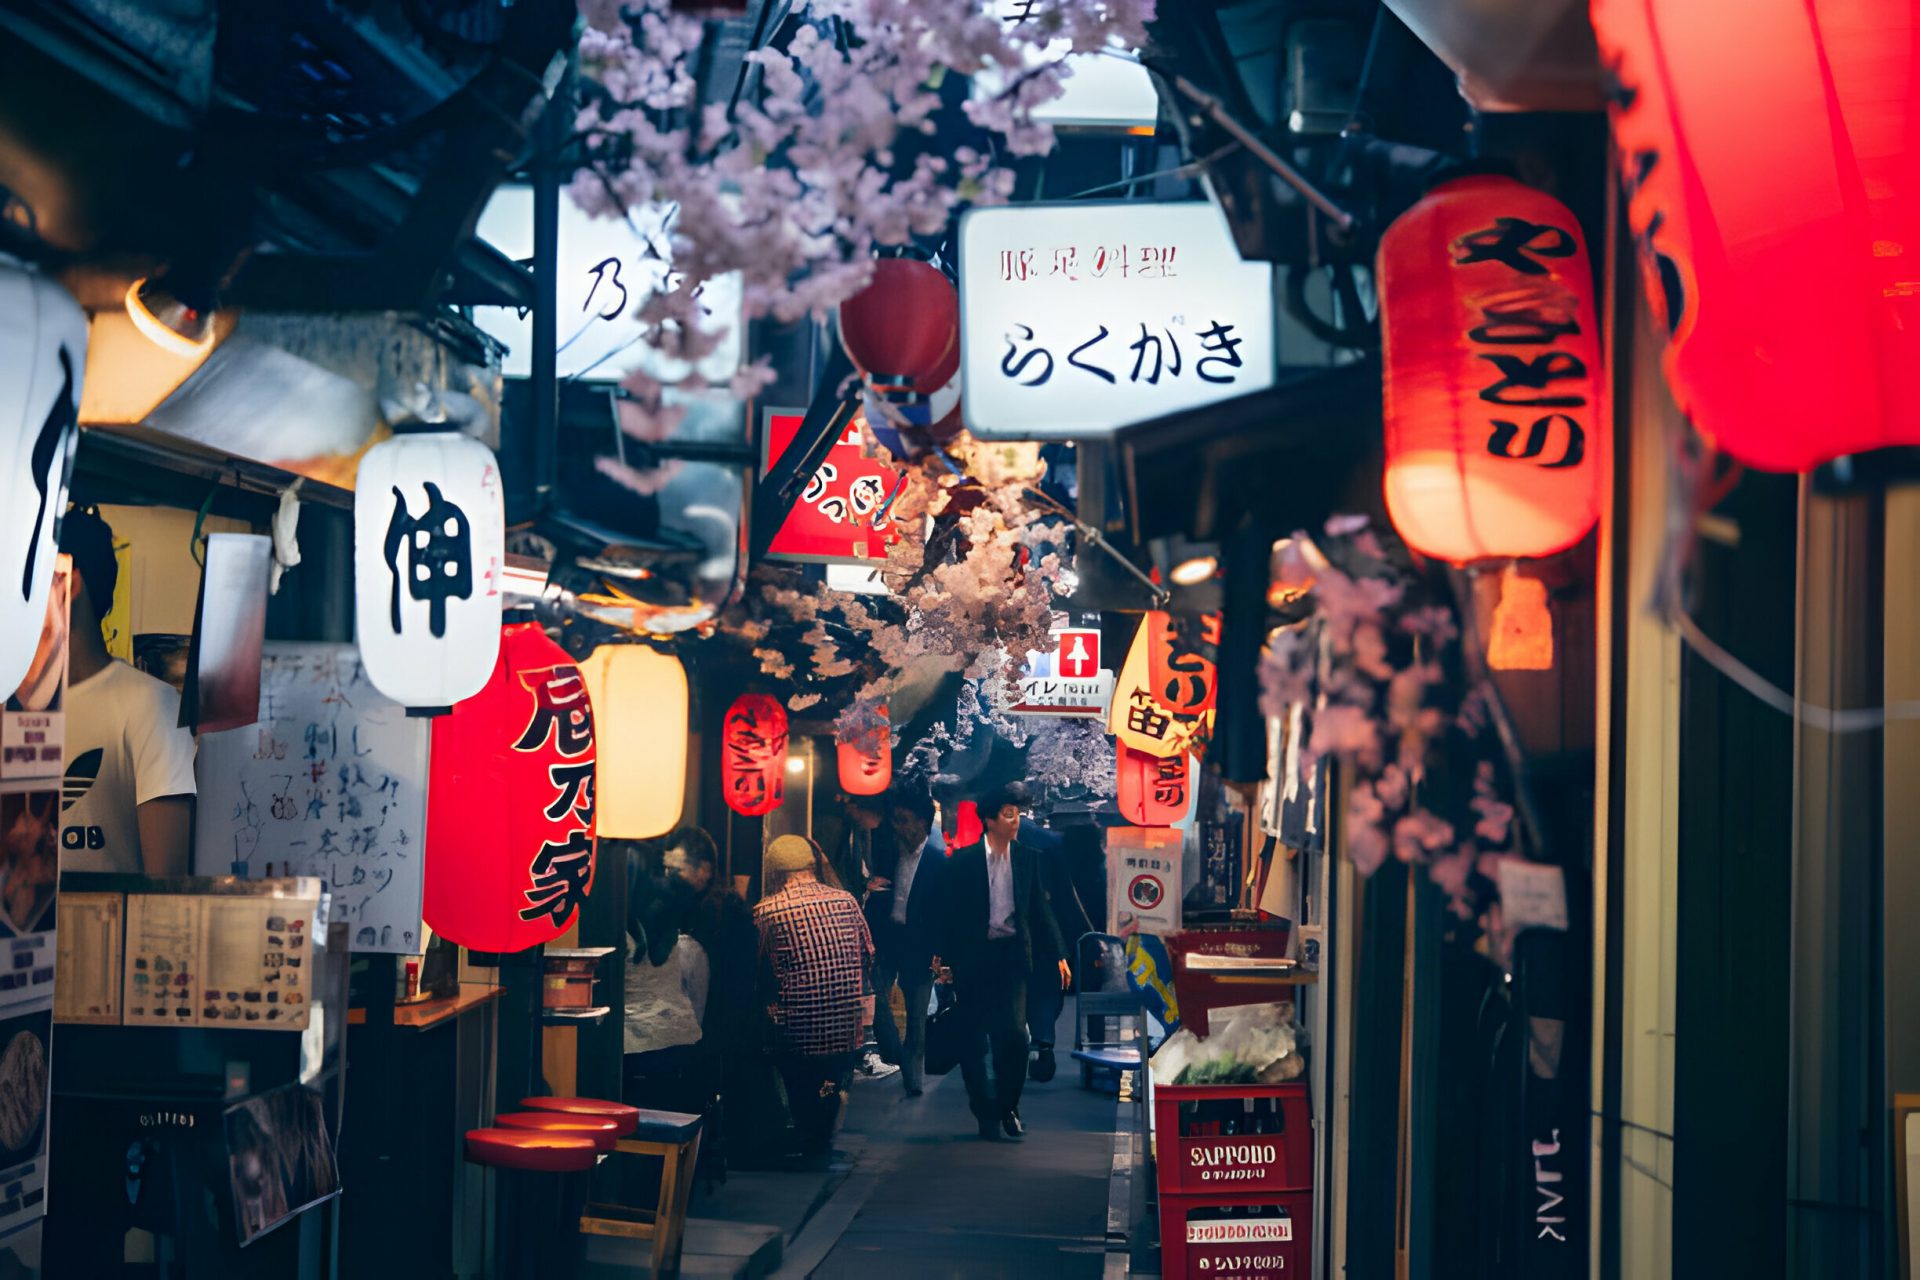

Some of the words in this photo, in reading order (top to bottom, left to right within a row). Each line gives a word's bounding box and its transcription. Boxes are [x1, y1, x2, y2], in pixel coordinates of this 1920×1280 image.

[1000, 320, 1243, 387] らくがき
[384, 481, 473, 639] 伸
